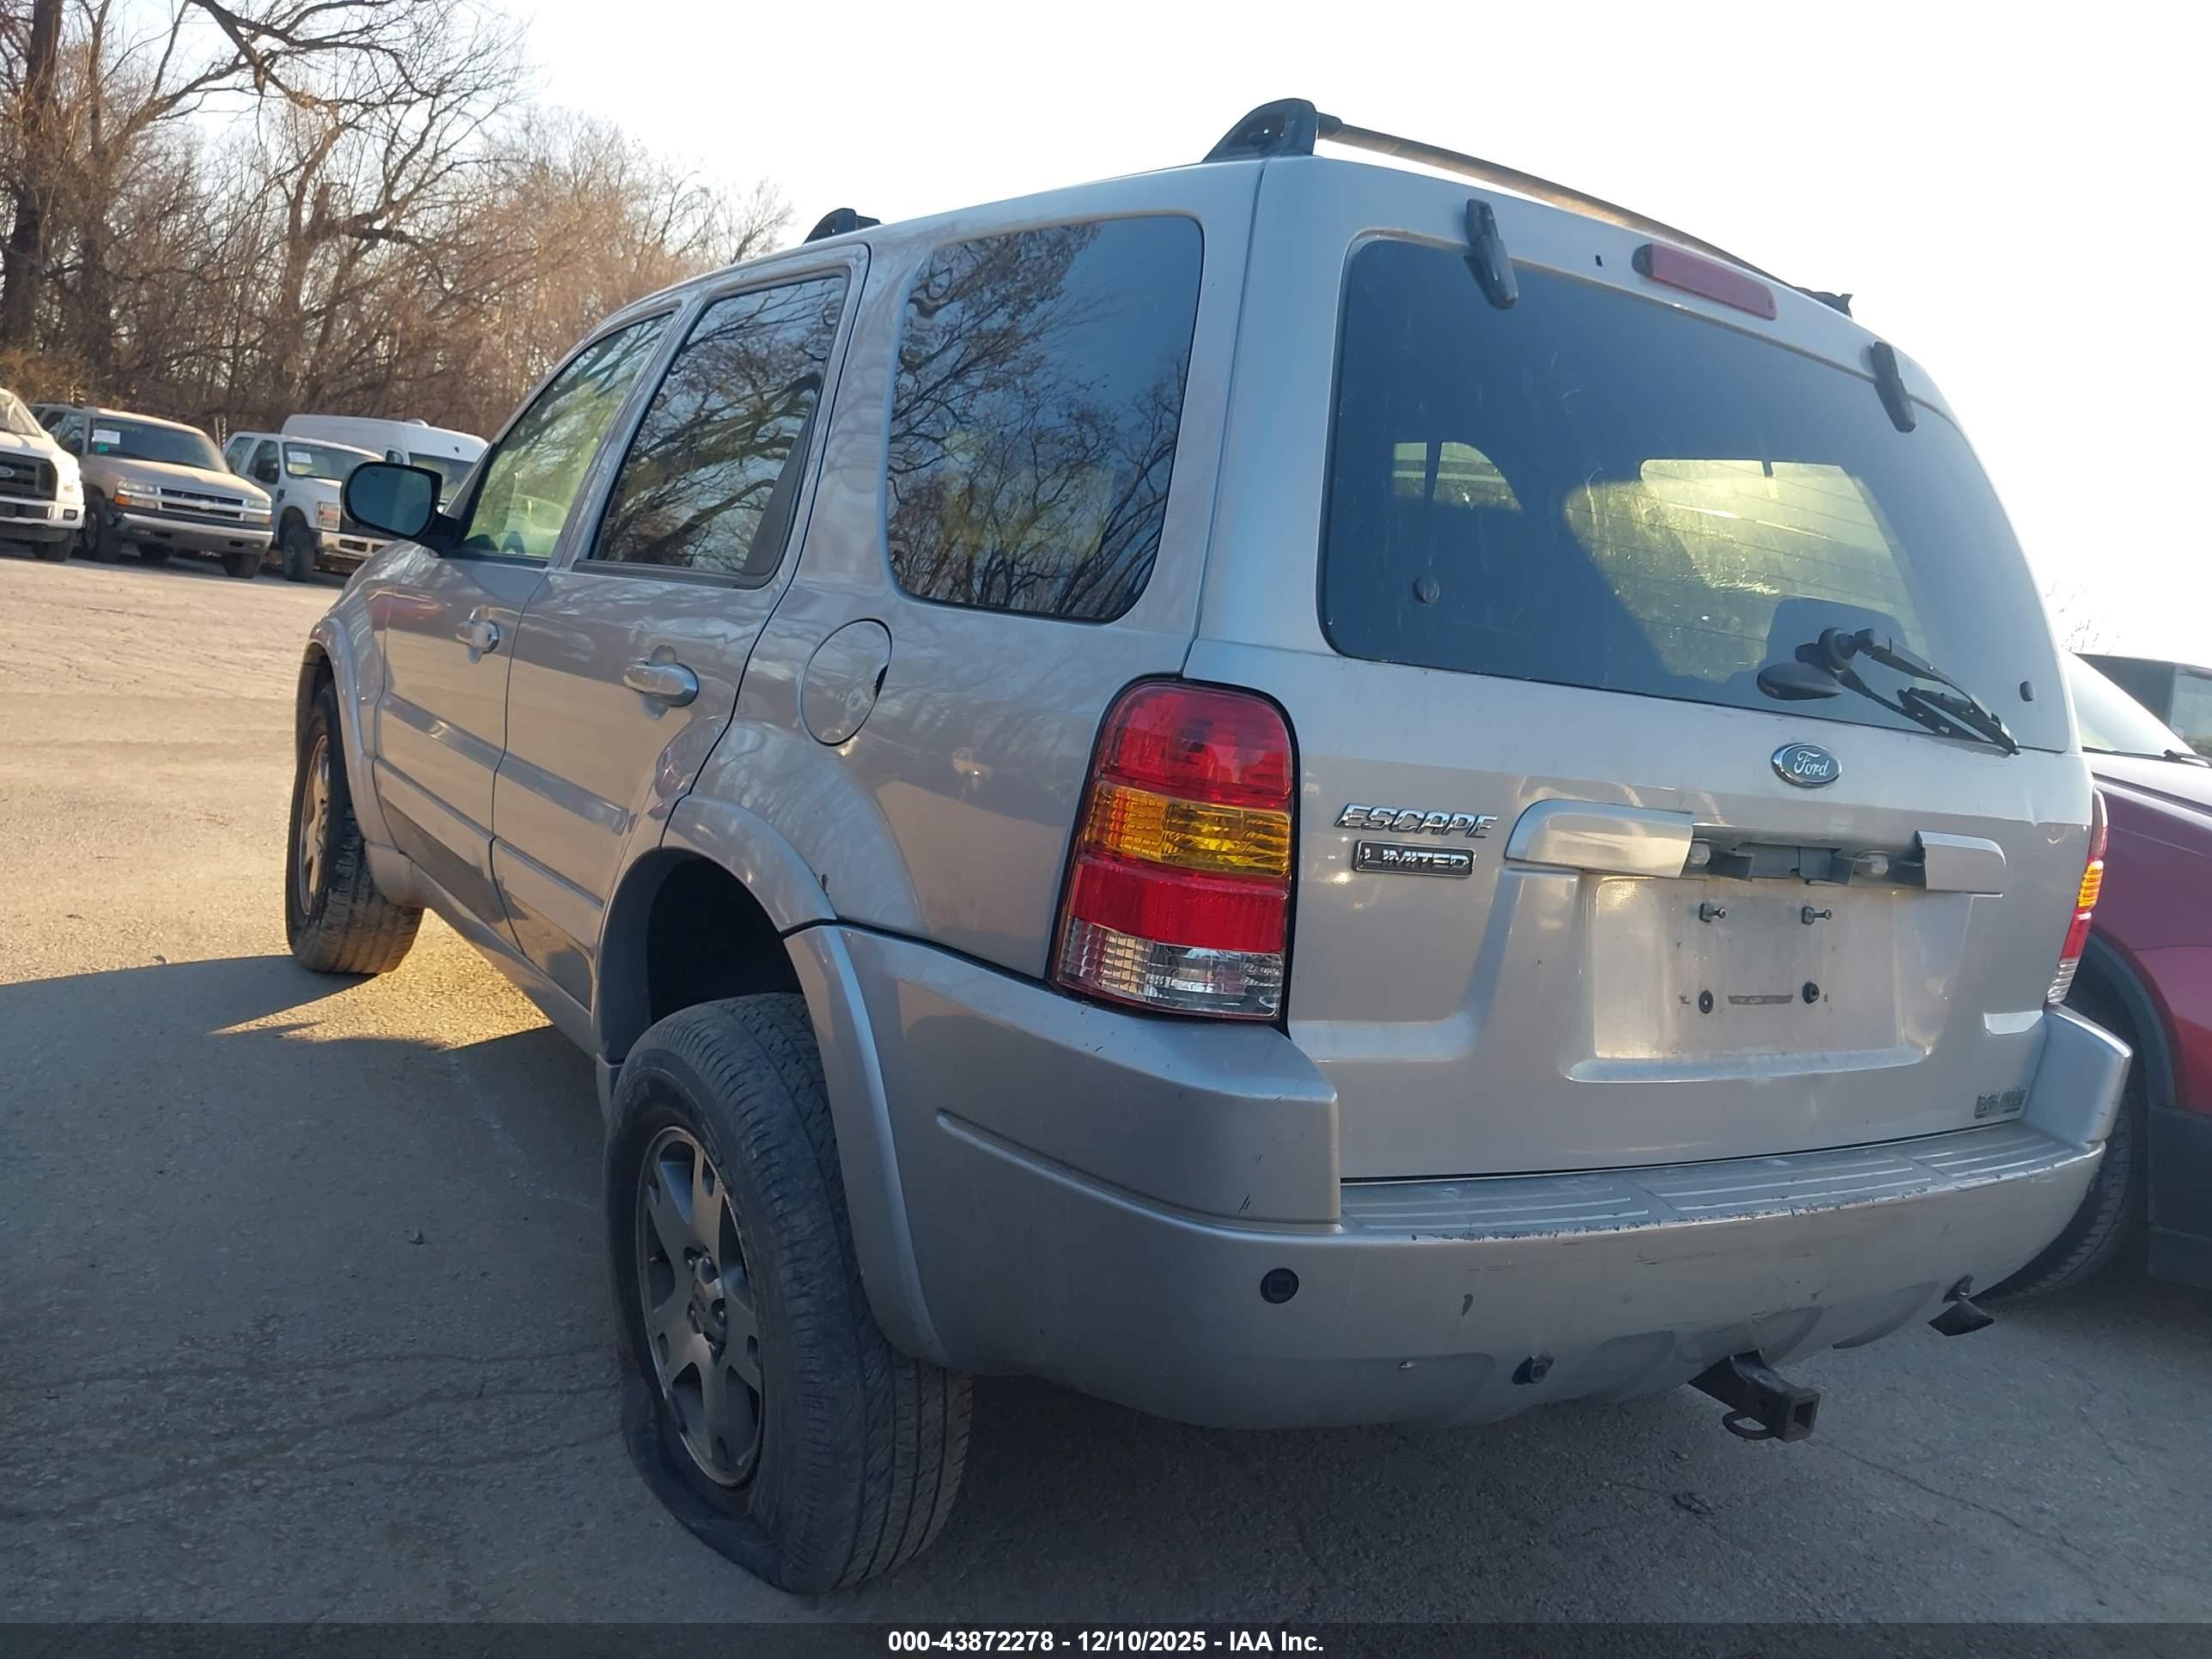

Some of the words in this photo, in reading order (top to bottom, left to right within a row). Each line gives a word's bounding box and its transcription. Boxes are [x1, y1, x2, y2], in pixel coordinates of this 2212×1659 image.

[1794, 750, 1829, 776] Ford
[1334, 803, 1498, 838] ESCAPE
[1359, 847, 1471, 870] LIMITED
